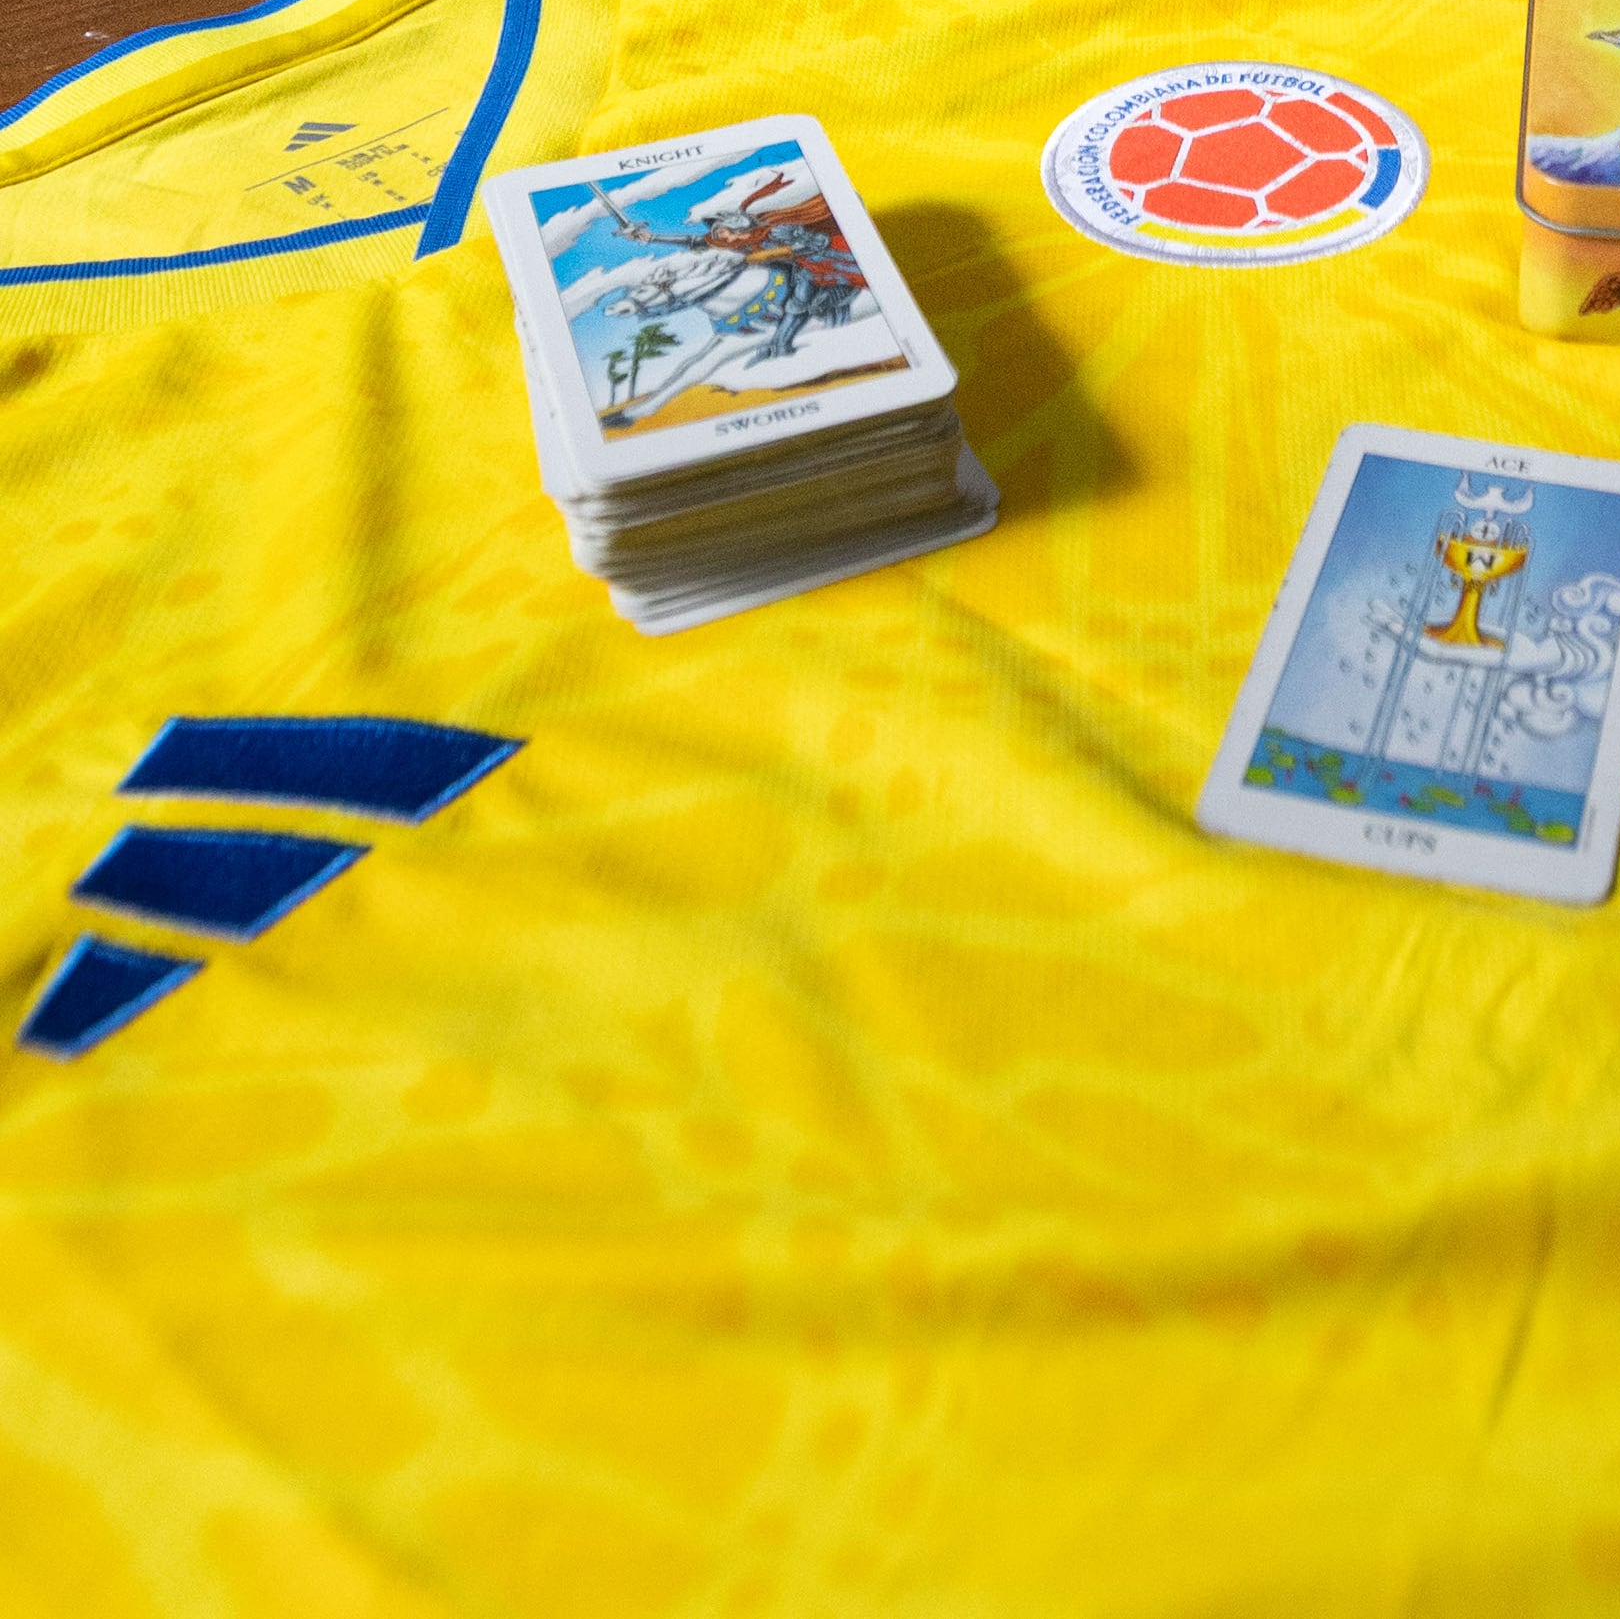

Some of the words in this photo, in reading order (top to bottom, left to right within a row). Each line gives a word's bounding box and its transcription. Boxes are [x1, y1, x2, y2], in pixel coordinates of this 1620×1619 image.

[1084, 78, 1202, 143] COLOMBIANA
[1205, 72, 1233, 87] DE
[618, 144, 704, 171] KNIGHT
[282, 175, 316, 195] M
[714, 401, 820, 437] SWORDS
[1484, 455, 1531, 474] ACE
[1362, 820, 1438, 854] CUPS
